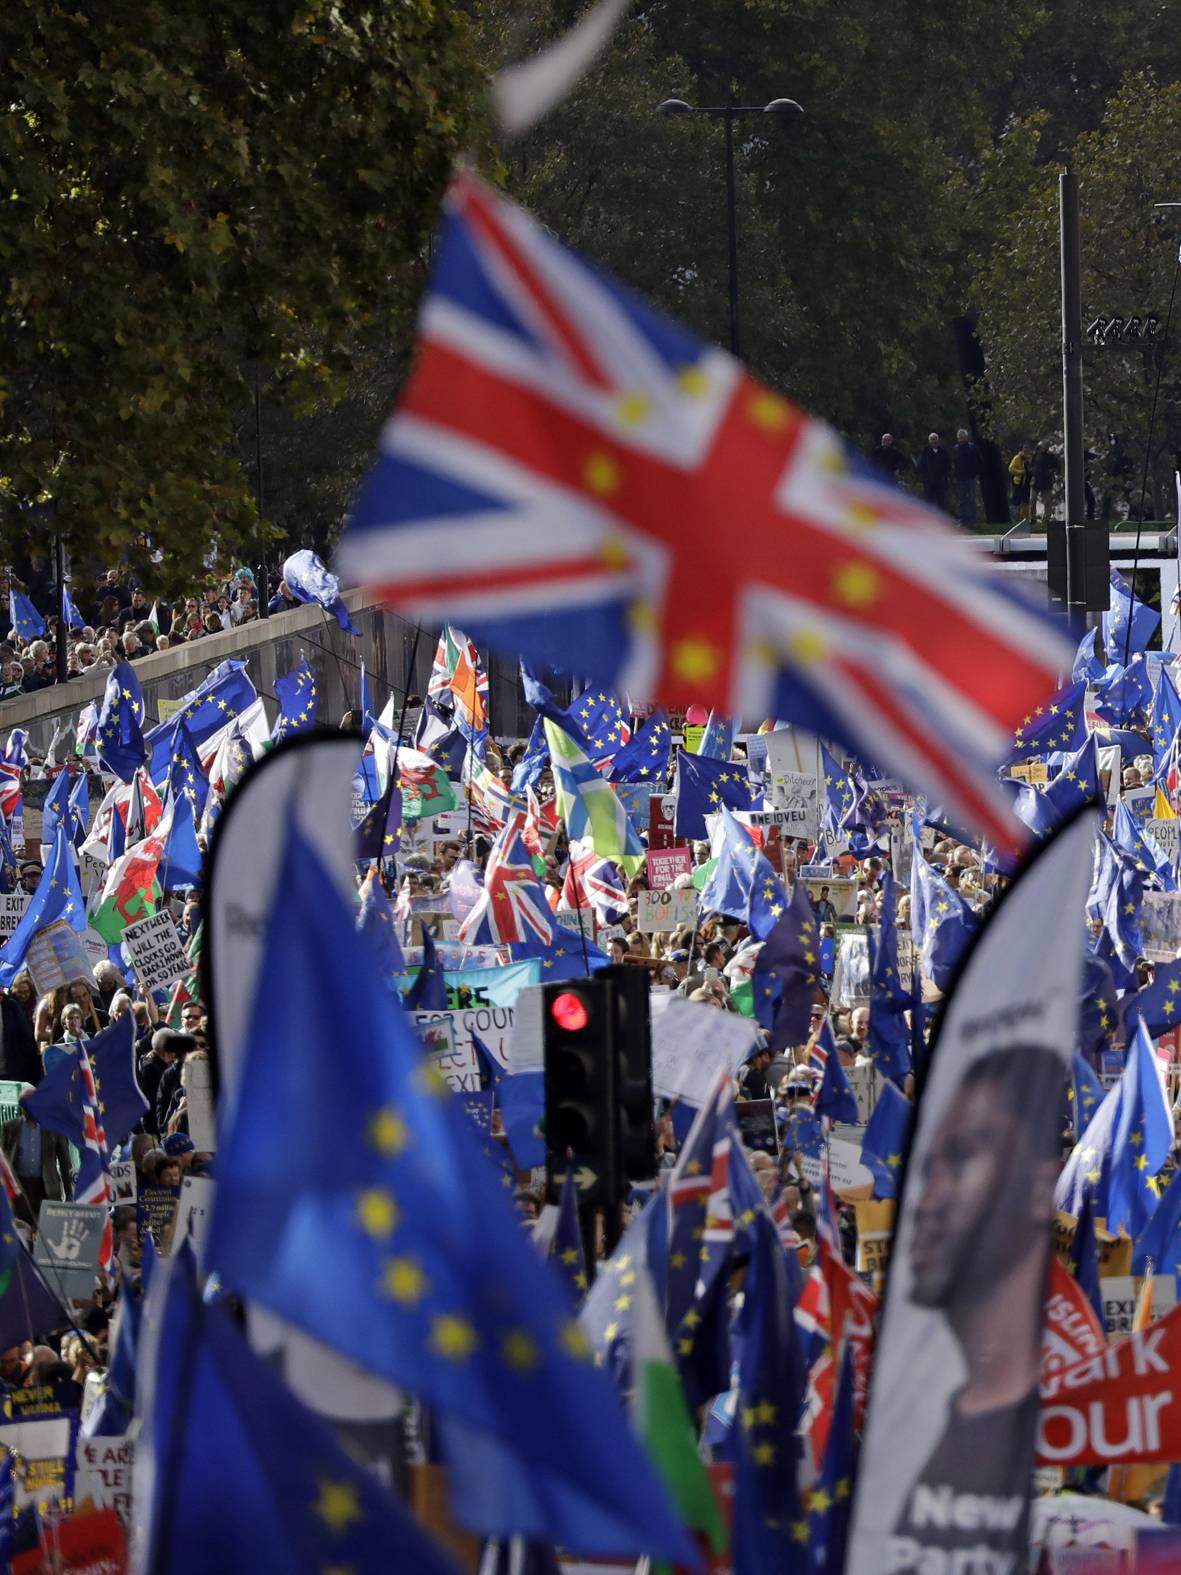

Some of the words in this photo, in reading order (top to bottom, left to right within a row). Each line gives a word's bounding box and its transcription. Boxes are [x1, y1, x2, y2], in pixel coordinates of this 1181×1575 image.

[6, 898, 24, 911] EXIT
[125, 922, 150, 943] NEXT
[150, 912, 170, 929] WEEK
[133, 939, 155, 956] WILL
[154, 928, 173, 943] THE
[134, 949, 164, 968] CLOCKS
[164, 942, 176, 953] GO
[142, 960, 160, 977] BACK
[164, 948, 185, 965] HOUR
[145, 977, 158, 988] OR
[168, 959, 191, 976] YEARS
[1036, 1390, 1172, 1459] our
[912, 1485, 1024, 1530] New
